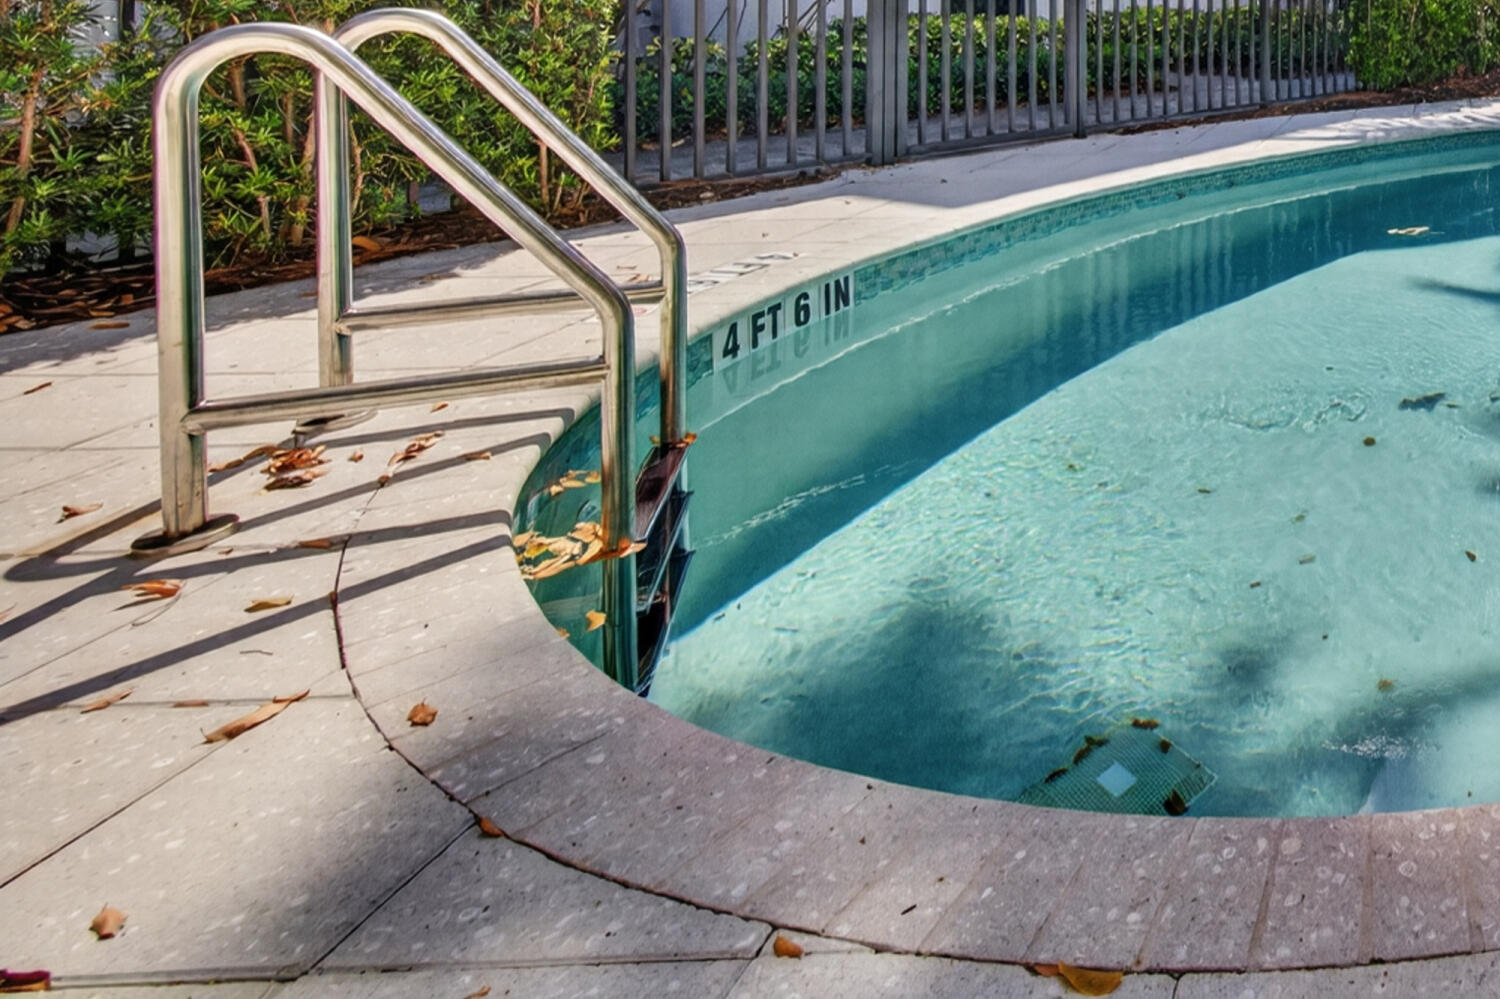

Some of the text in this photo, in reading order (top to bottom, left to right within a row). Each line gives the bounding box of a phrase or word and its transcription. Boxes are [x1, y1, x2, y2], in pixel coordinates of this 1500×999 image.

[722, 275, 850, 359] 4 FT 6 IN
